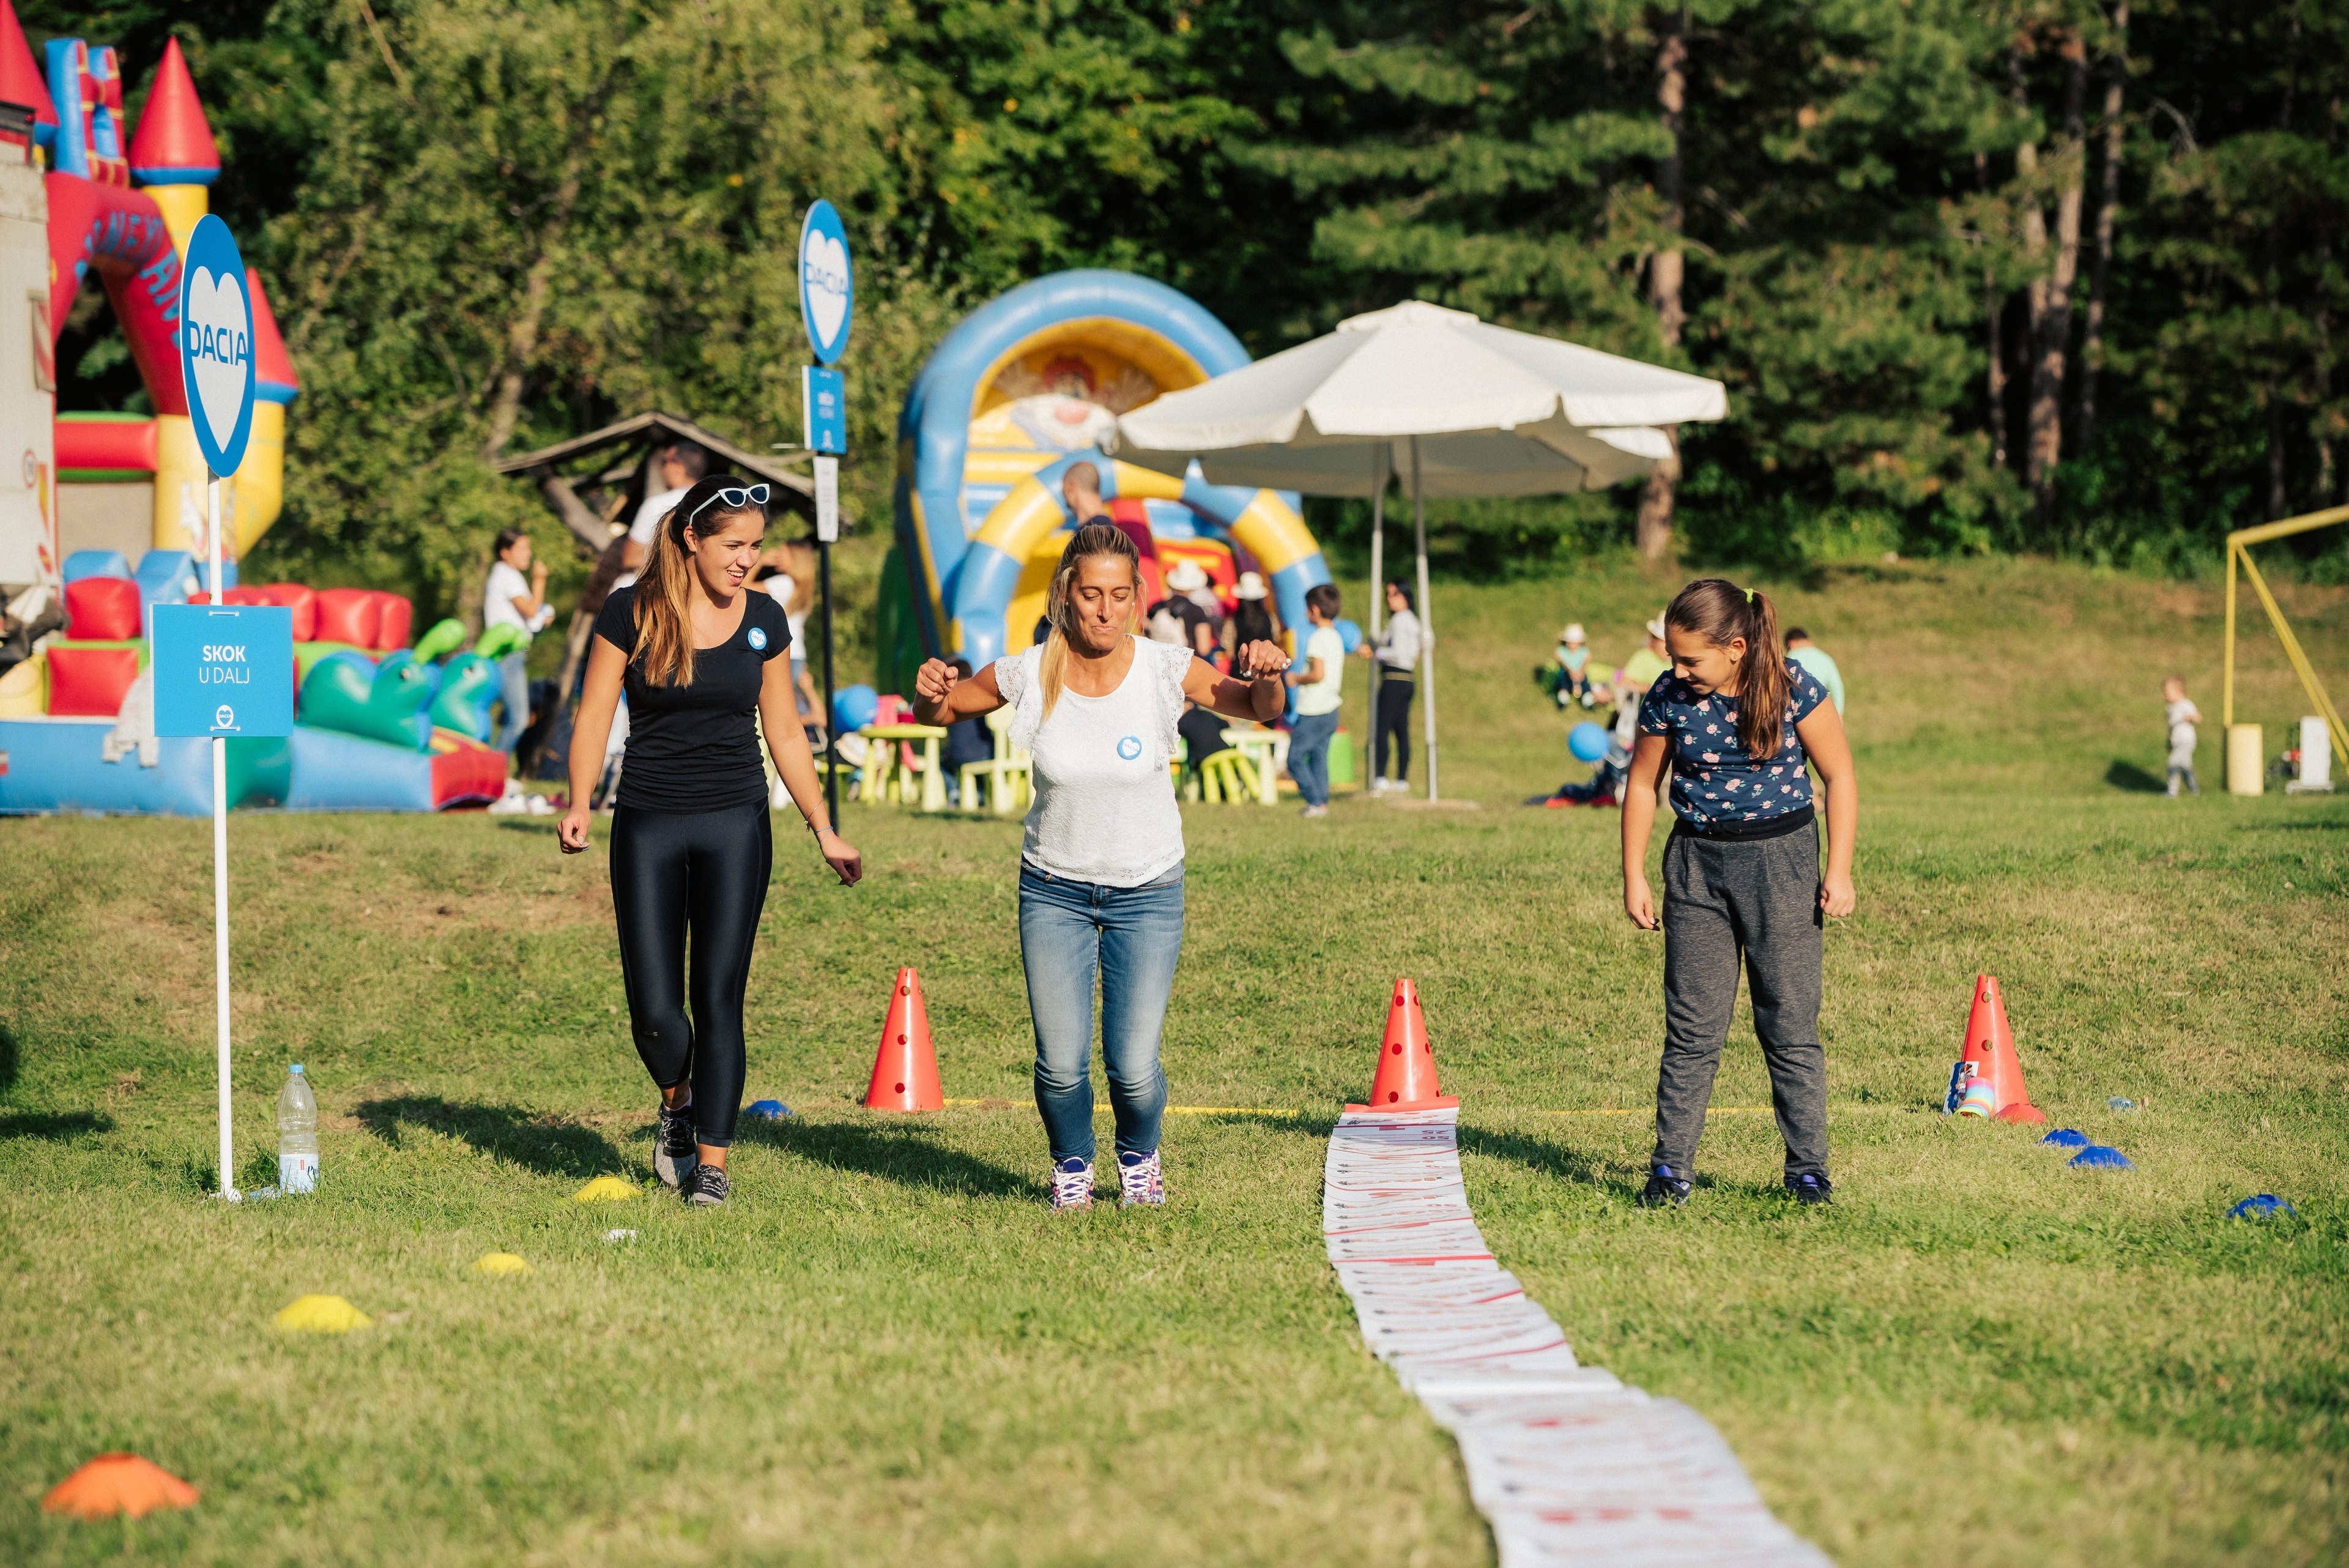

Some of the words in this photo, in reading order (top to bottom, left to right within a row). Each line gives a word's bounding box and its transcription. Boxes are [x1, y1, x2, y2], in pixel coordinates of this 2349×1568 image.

[805, 262, 847, 294] DACIA
[188, 320, 248, 366] DACIA
[751, 634, 765, 642] DACIA
[202, 645, 246, 662] SKOK
[199, 667, 209, 683] U
[214, 667, 250, 684] DALJ
[1123, 742, 1139, 752] DACIA
